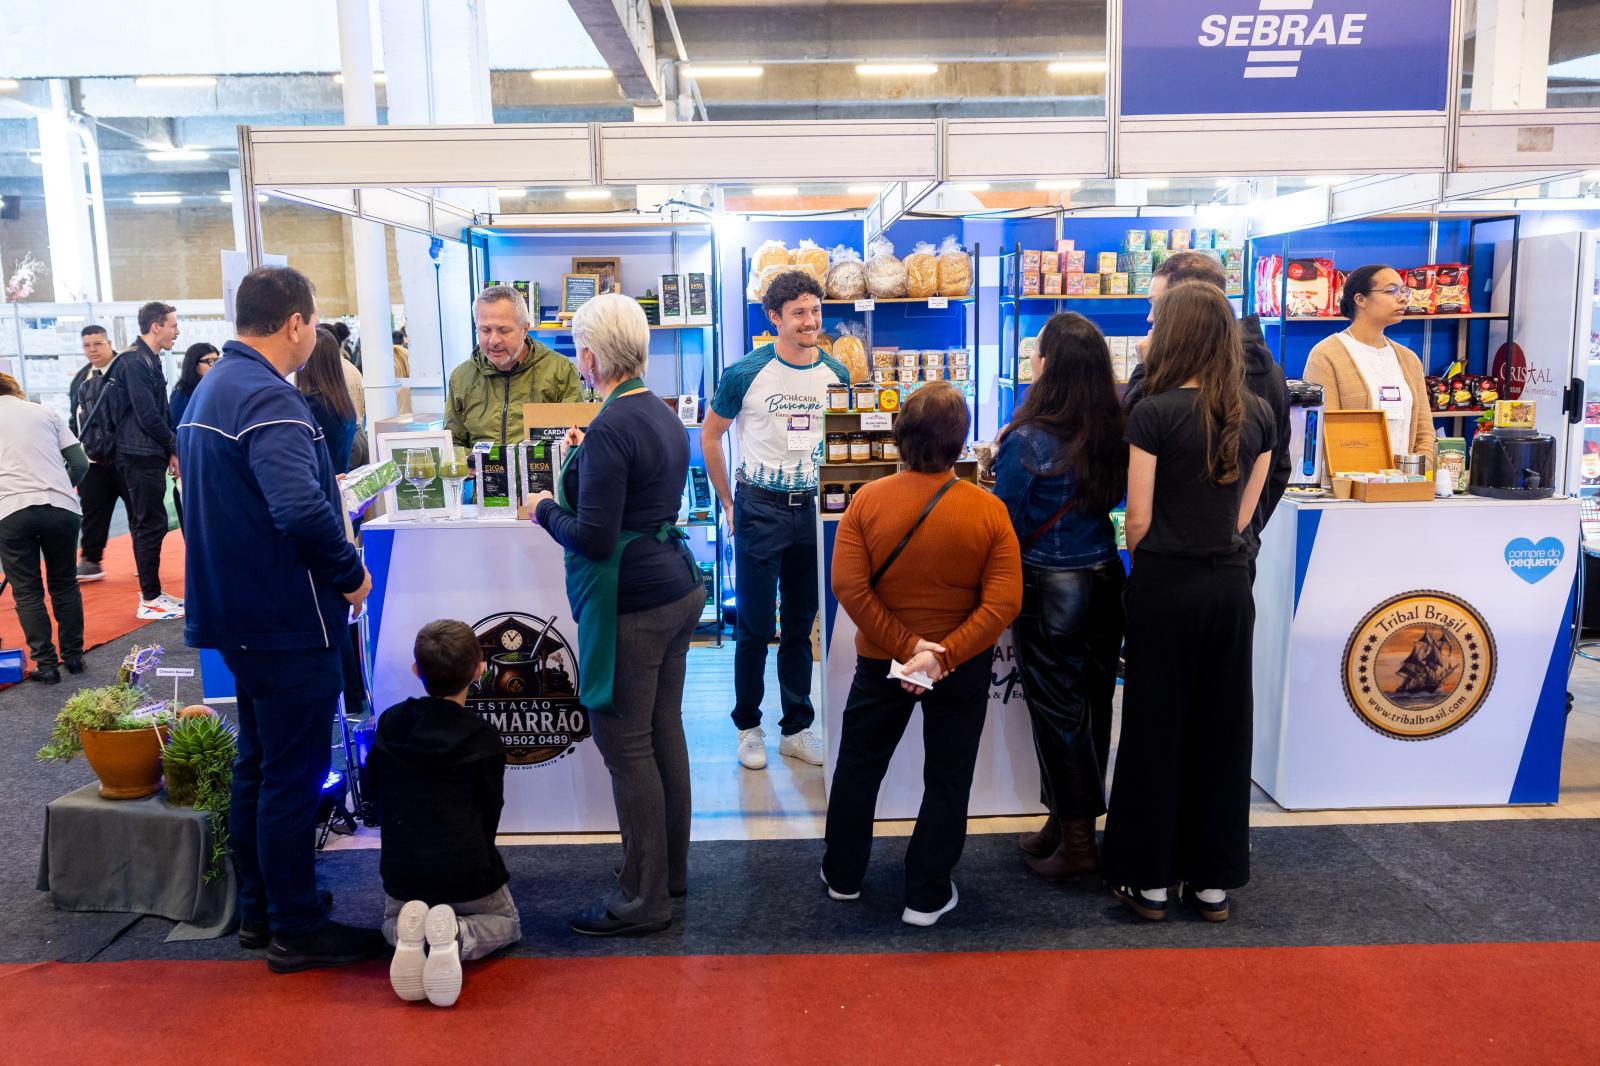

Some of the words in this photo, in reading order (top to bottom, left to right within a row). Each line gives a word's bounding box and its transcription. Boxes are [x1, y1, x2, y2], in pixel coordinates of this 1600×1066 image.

[1198, 14, 1368, 47] SEBRAE
[765, 393, 823, 413] Buscapé
[783, 394, 817, 402] CHÁCARA
[1509, 550, 1546, 559] compre
[1547, 547, 1561, 558] do
[1509, 558, 1560, 569] pequeno
[1375, 605, 1419, 633] Tribal
[1425, 605, 1468, 633] Brasil
[478, 700, 551, 712] ESTAÇÃO
[1367, 695, 1467, 725] www.tribalbrasil.com
[481, 708, 584, 733] MARRÃO
[538, 735, 568, 745] 0489
